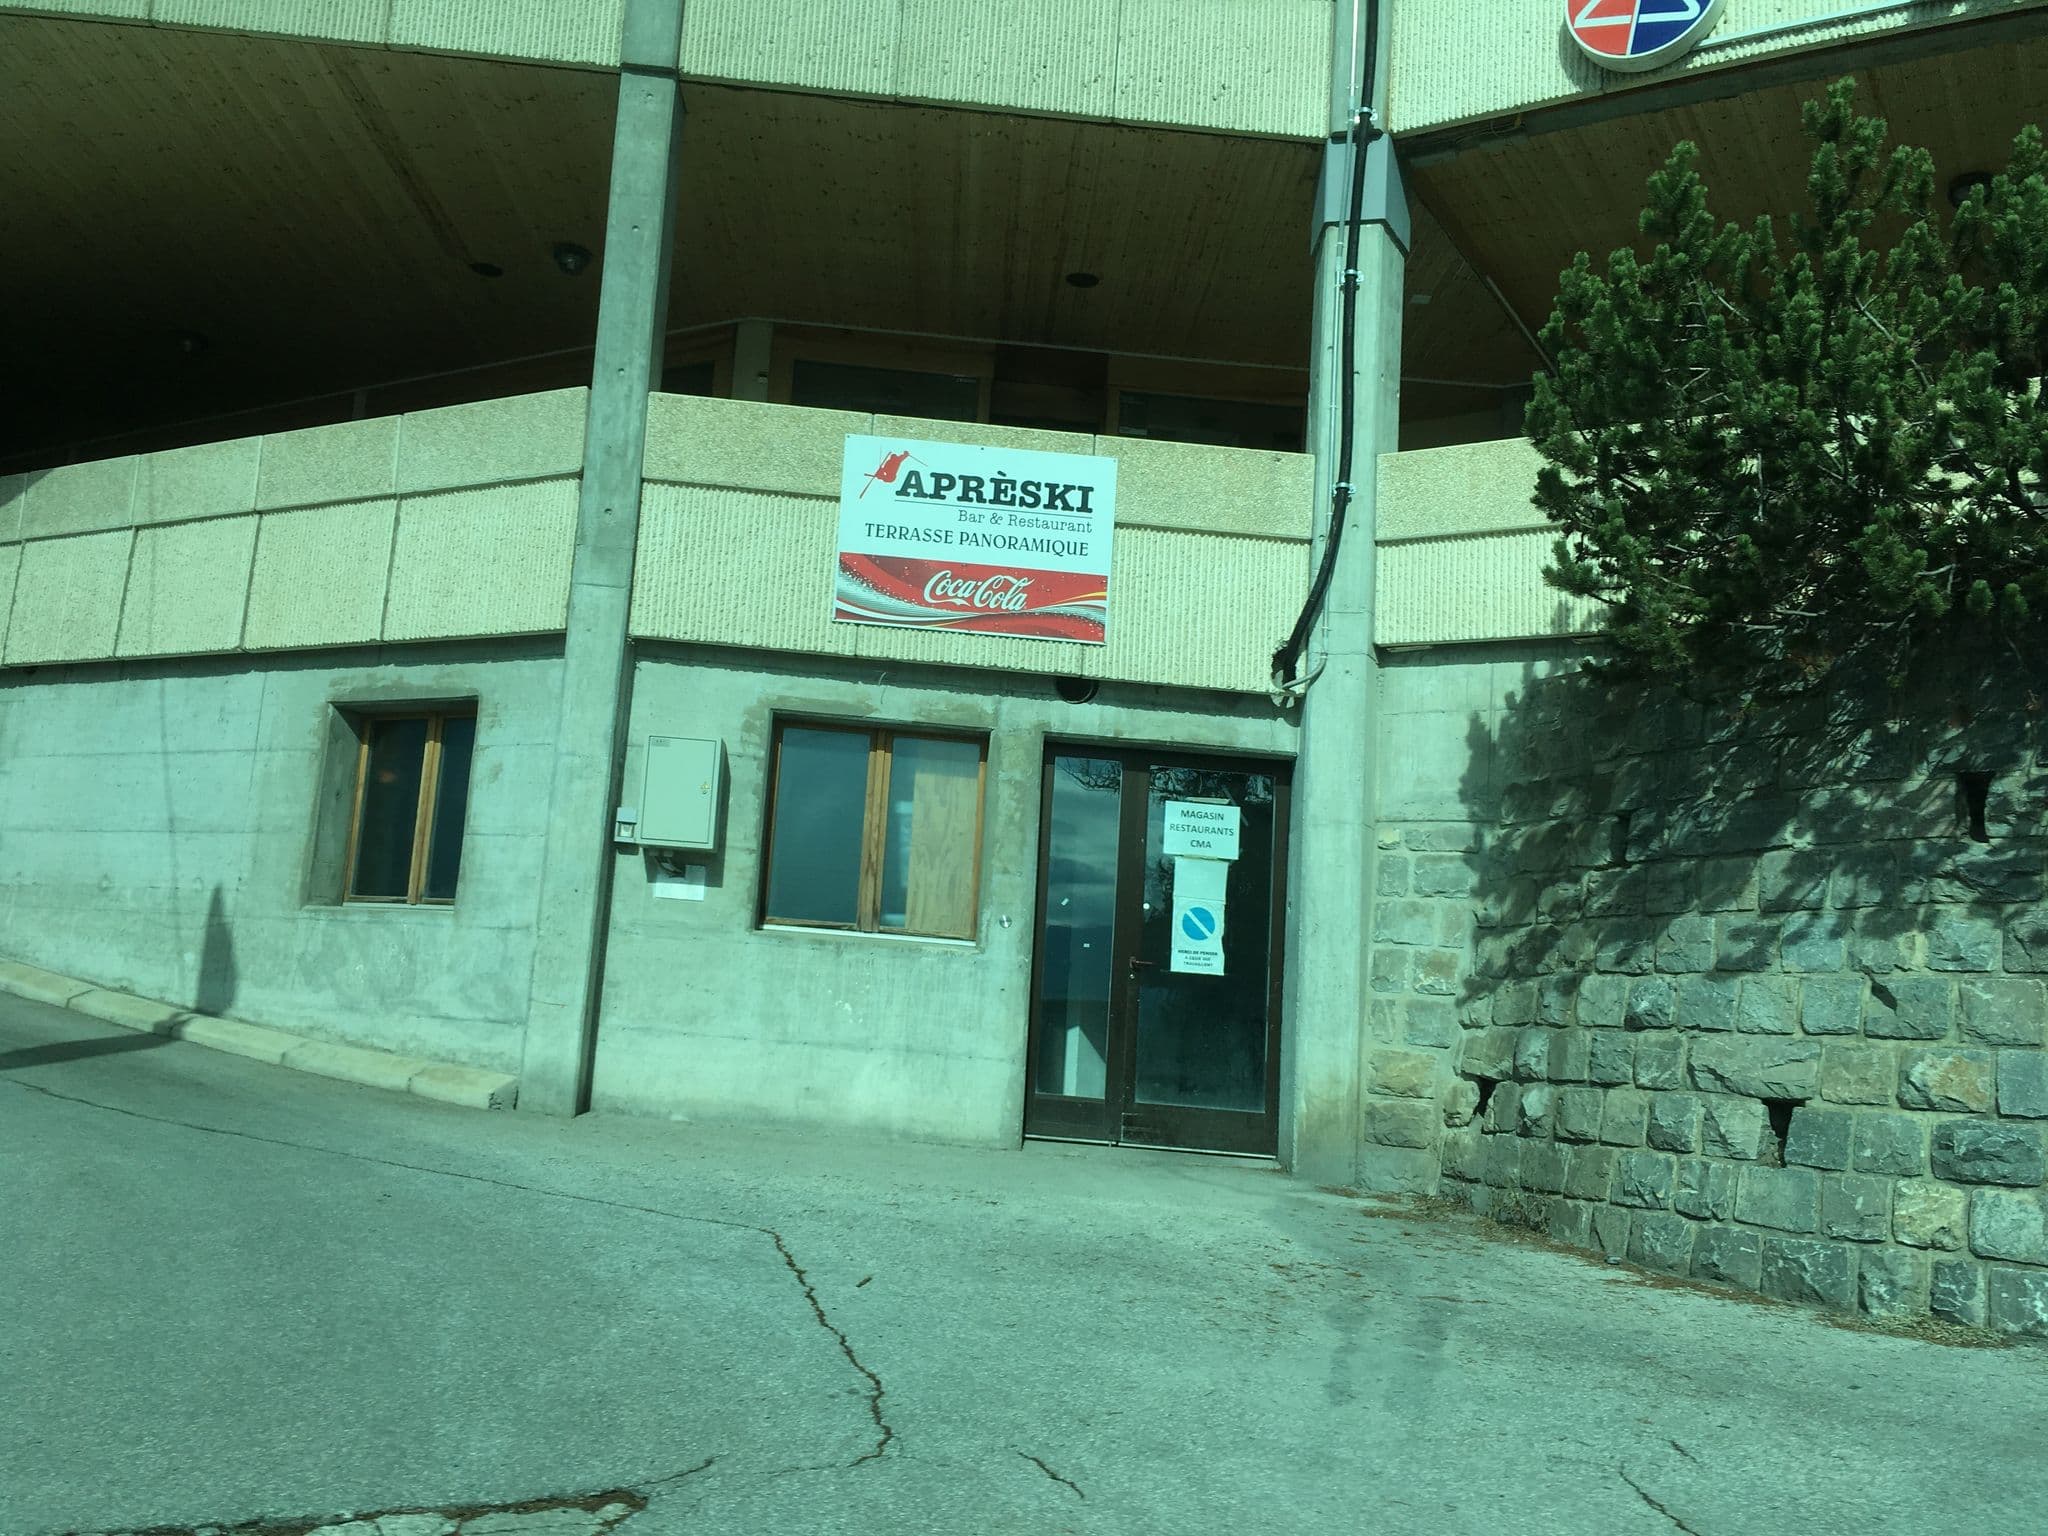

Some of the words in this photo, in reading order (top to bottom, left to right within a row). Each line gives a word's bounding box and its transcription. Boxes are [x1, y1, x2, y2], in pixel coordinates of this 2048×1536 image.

[895, 470, 1094, 513] APRÈSKI
[957, 509, 985, 524] Bar
[990, 514, 1003, 525] &
[1007, 514, 1092, 533] Restaurant
[865, 522, 954, 544] TERRASSE
[959, 531, 1089, 557] PANORAMIQUE
[923, 570, 1035, 611] Coca-Cola
[1181, 809, 1225, 821] MAGASIN
[1169, 823, 1234, 837] RESTAURANTS
[1190, 839, 1212, 849] CMA
